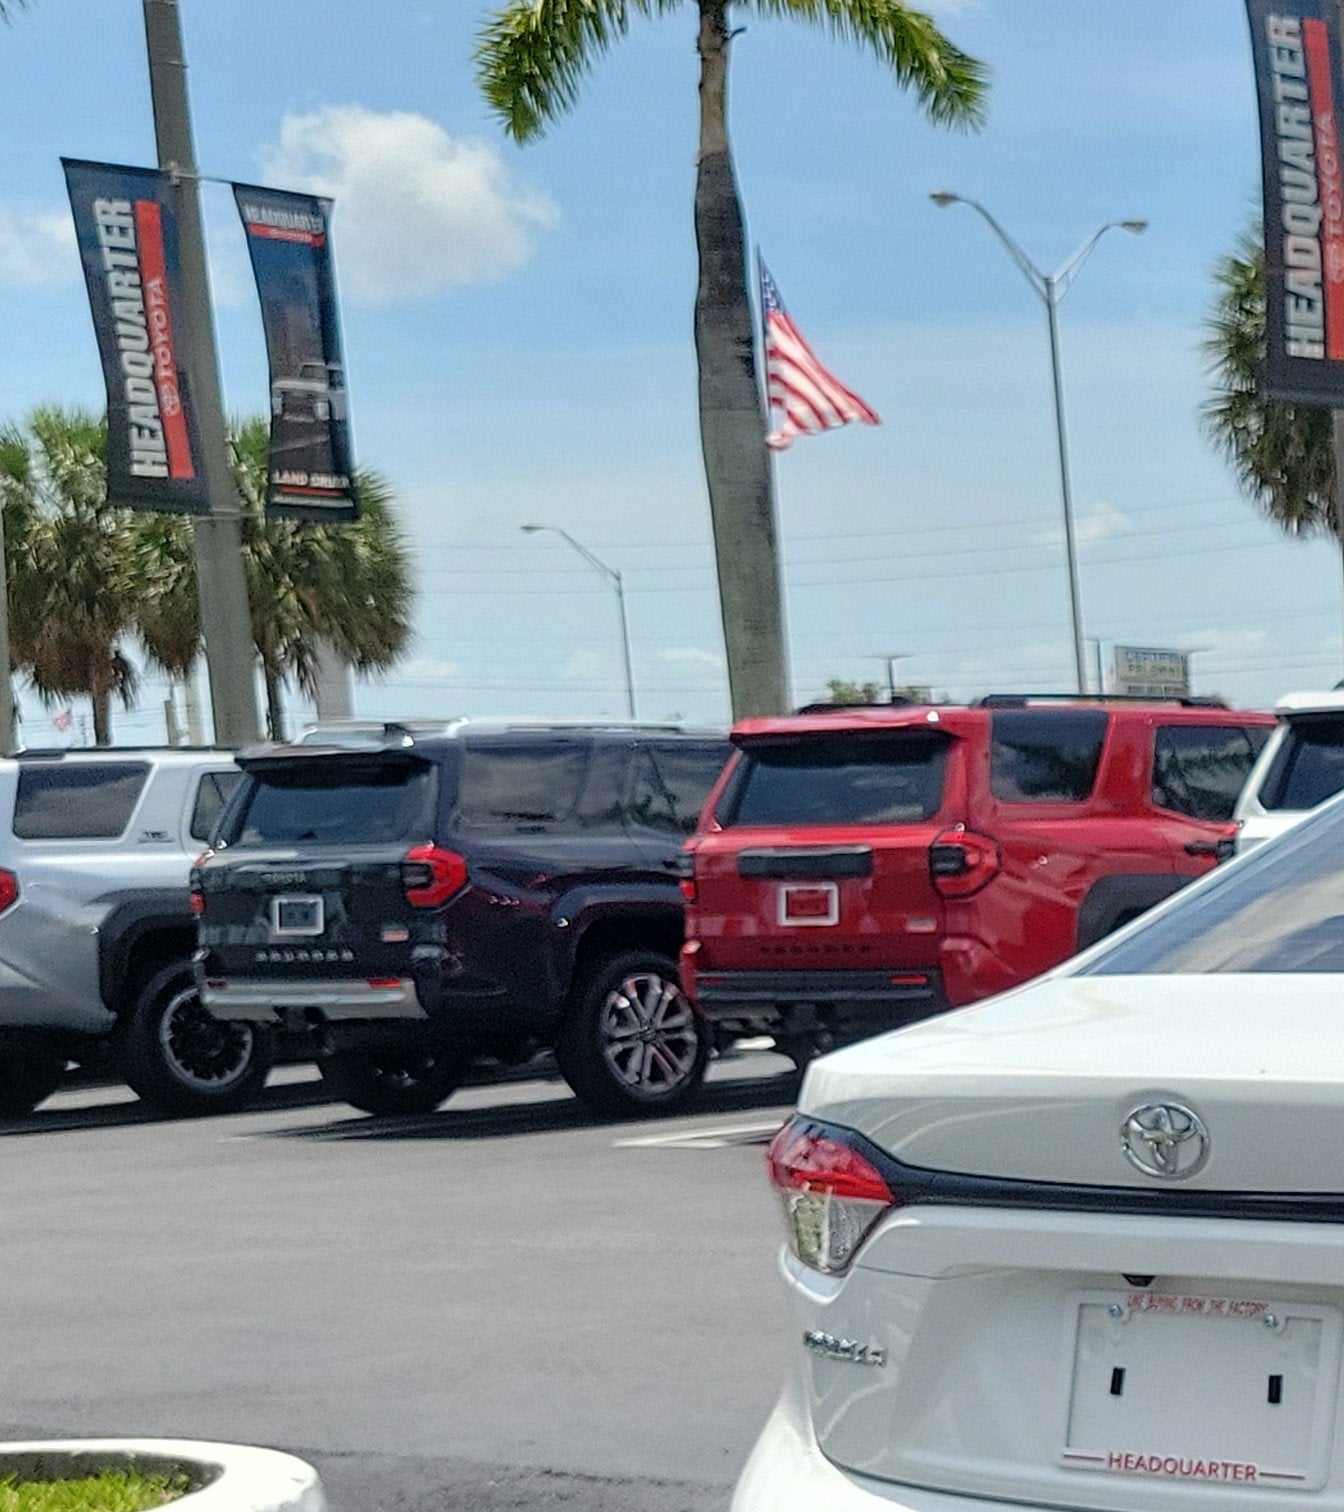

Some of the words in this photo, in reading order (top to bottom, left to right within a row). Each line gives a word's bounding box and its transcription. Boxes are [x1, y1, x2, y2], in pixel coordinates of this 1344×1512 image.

[1265, 15, 1326, 360] HEADQUARTER
[1316, 110, 1344, 237] TOYOTA
[94, 198, 169, 479] HEADQUARTER
[145, 279, 175, 379] TOYOTA
[272, 470, 308, 486] LAND
[1108, 1452, 1258, 1481] HEADQUARTER
